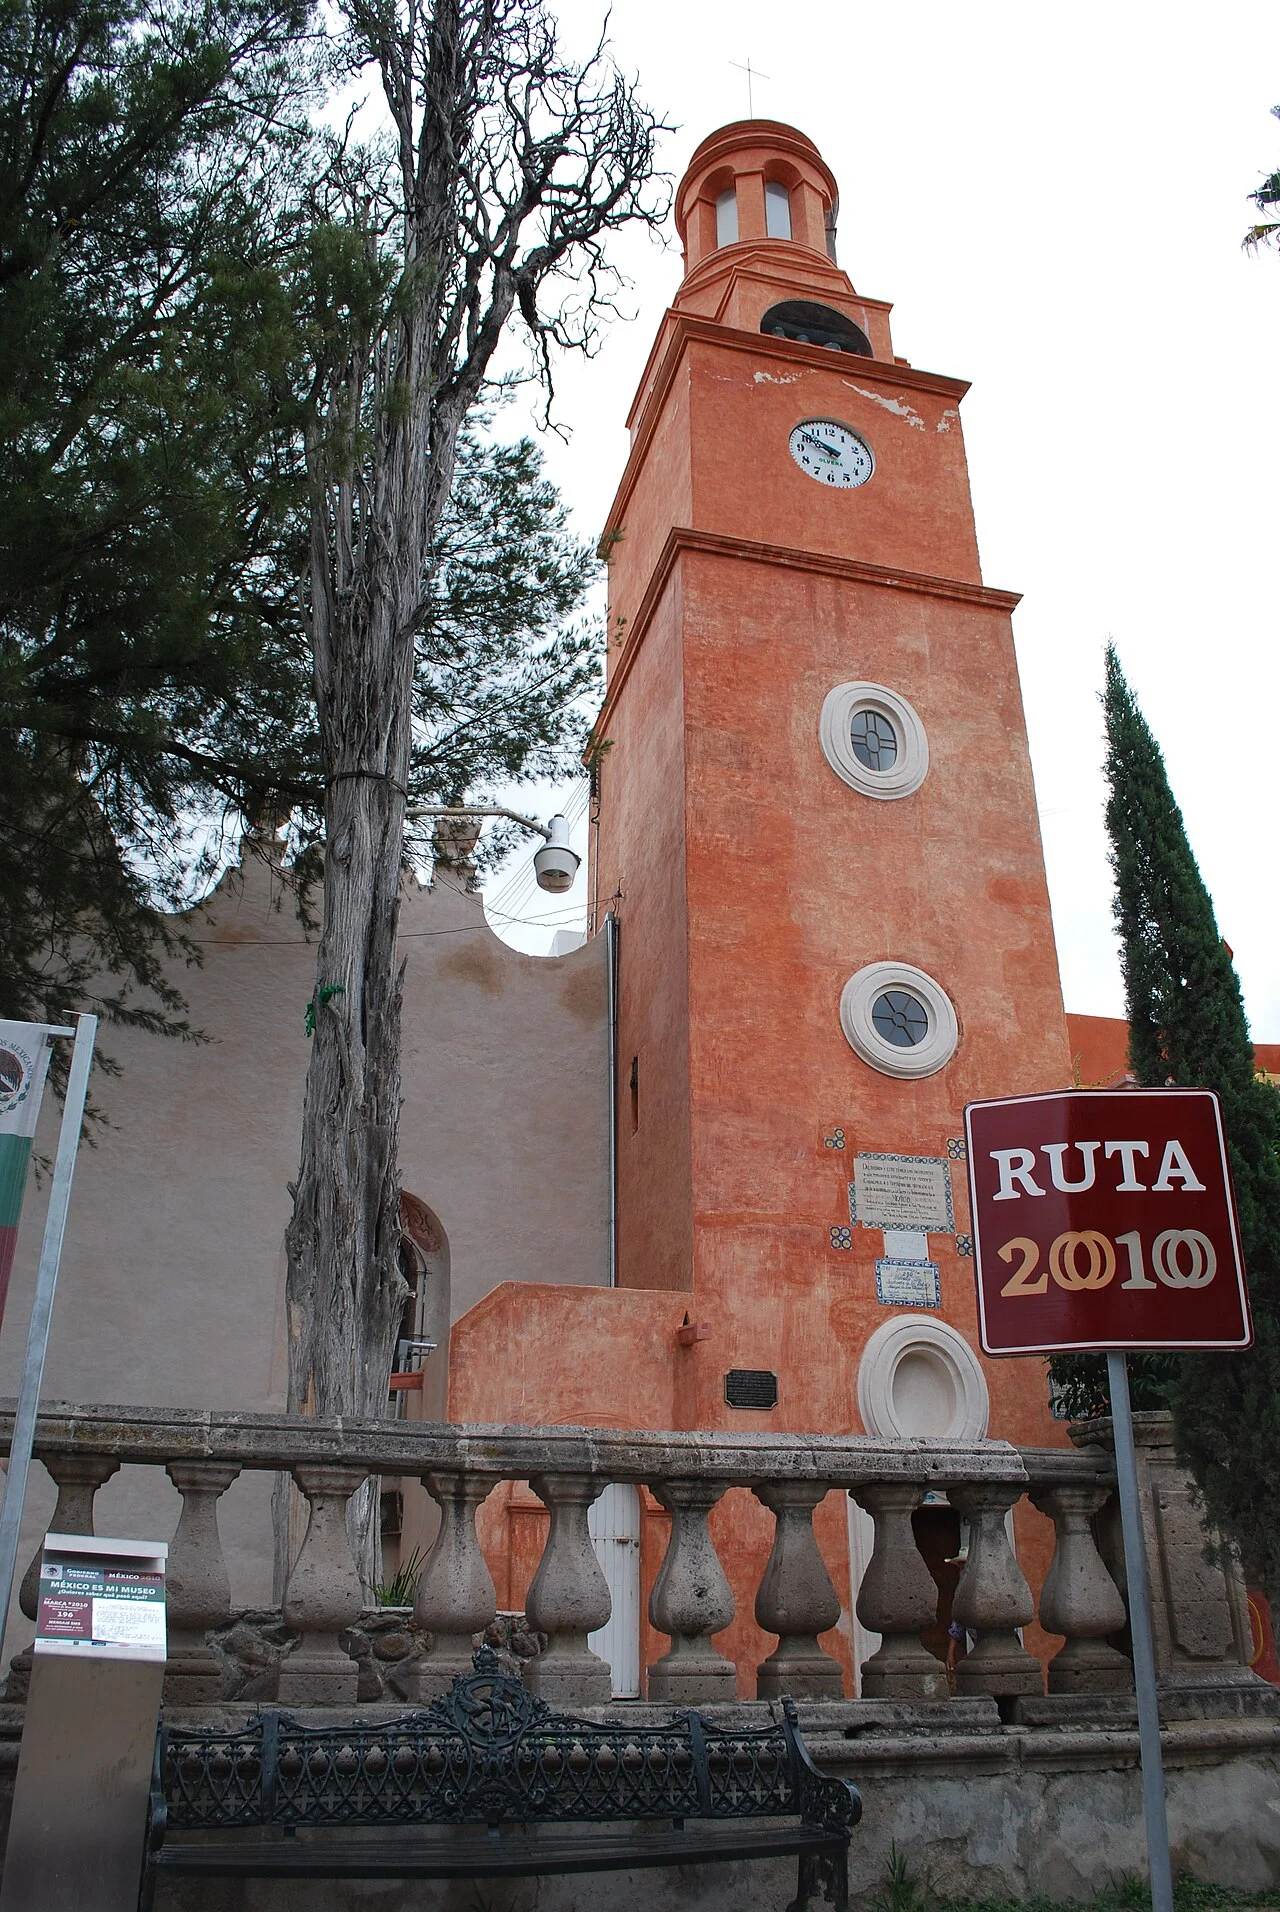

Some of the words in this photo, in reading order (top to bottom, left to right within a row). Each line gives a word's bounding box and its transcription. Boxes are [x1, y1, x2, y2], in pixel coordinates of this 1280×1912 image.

[811, 428, 820, 437] 11
[825, 428, 835, 437] 12
[796, 444, 804, 452] 9
[851, 446, 859, 454] 2
[802, 456, 810, 464] 8
[818, 458, 844, 467] OLVERA
[856, 458, 864, 466] 3
[814, 466, 821, 475] 7
[852, 467, 859, 476] 4
[827, 474, 835, 482] 6
[842, 472, 850, 482] 5
[989, 1140, 1207, 1201] RUTA
[50, 1580, 90, 1590] MÉXICO
[121, 1586, 156, 1595] MUSEO
